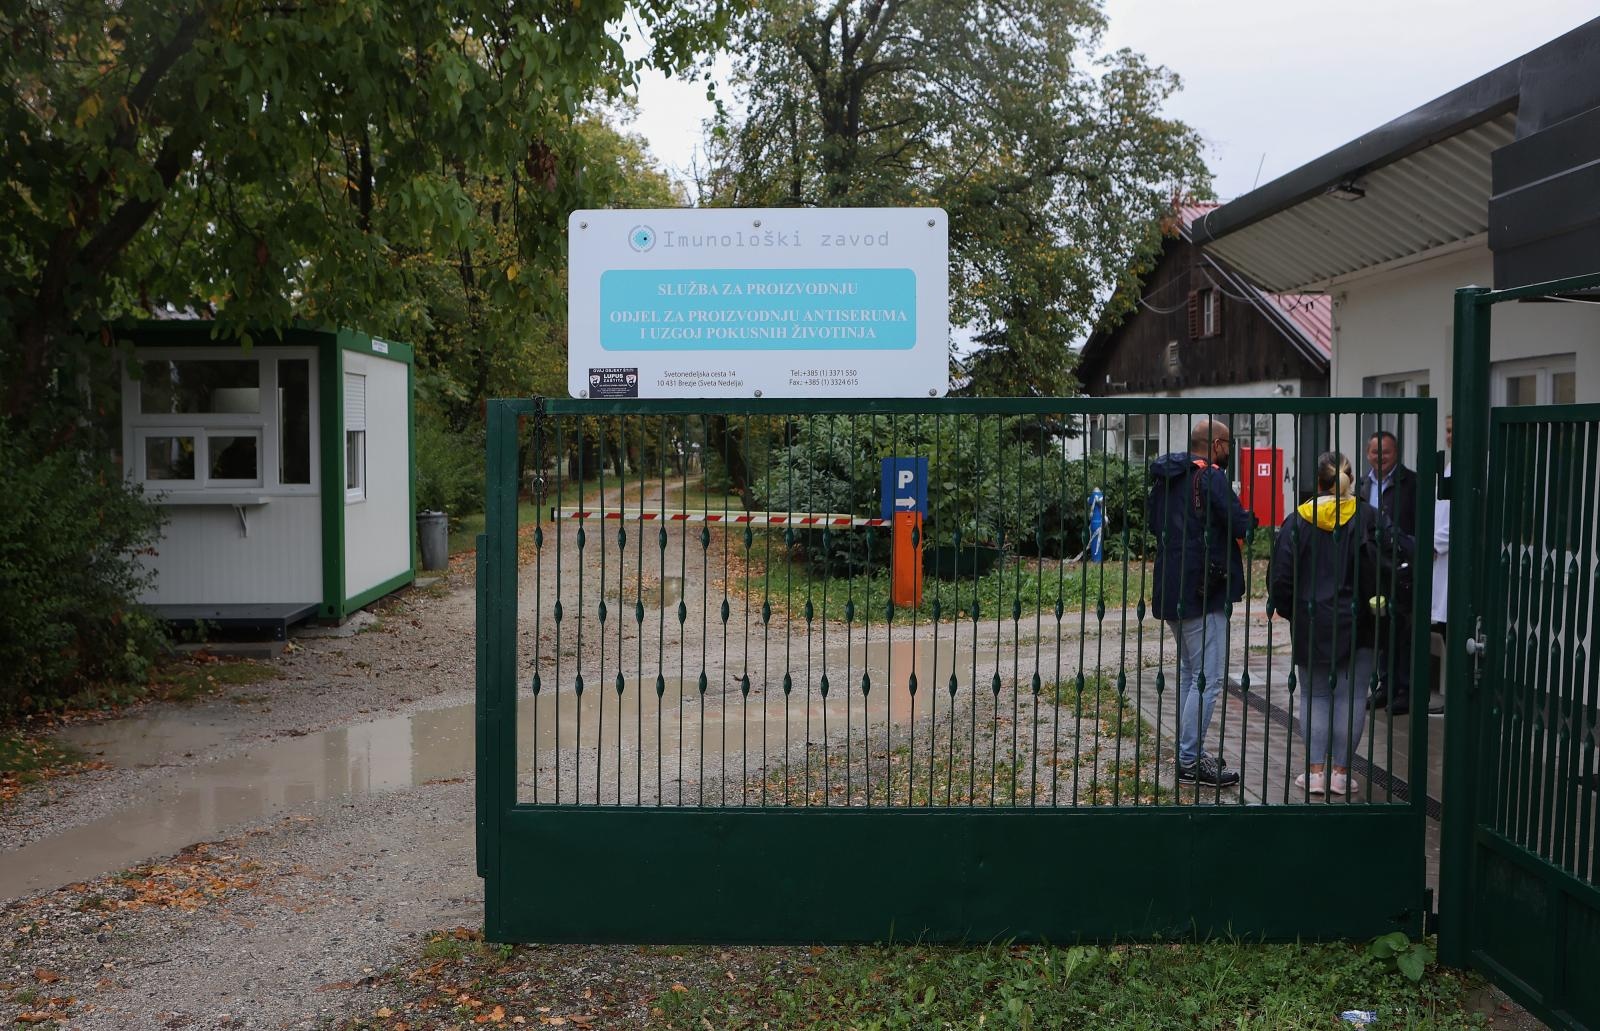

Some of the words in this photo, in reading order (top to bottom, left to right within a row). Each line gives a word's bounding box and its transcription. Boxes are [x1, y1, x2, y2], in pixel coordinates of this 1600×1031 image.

[663, 230, 802, 248] Imunološki
[821, 231, 889, 247] zavod
[657, 281, 719, 296] SLUŽBA
[722, 283, 743, 296] ZA
[746, 282, 858, 296] PROIZVODNJU
[609, 310, 661, 324] ODJEL
[664, 310, 684, 323] ZA
[688, 309, 799, 323] PROIZVODNJU
[803, 309, 907, 322] ANTISERUMA
[639, 327, 647, 339] I
[649, 327, 702, 339] UZGOJ
[707, 327, 788, 339] POKUSNIH
[791, 323, 877, 339] ŽIVOTINJA
[664, 370, 710, 378] Svetonedeljska
[710, 370, 727, 378] cesta
[820, 369, 828, 377] (1)
[829, 369, 844, 377] 3371
[845, 369, 857, 377] 550
[678, 380, 697, 388] Brezje
[717, 379, 744, 388] Nedelja)
[805, 378, 820, 386] +385
[821, 378, 830, 387] (1)
[830, 378, 846, 386] 3324
[847, 378, 859, 386] 615
[1260, 465, 1268, 474] H
[898, 470, 914, 489] P
